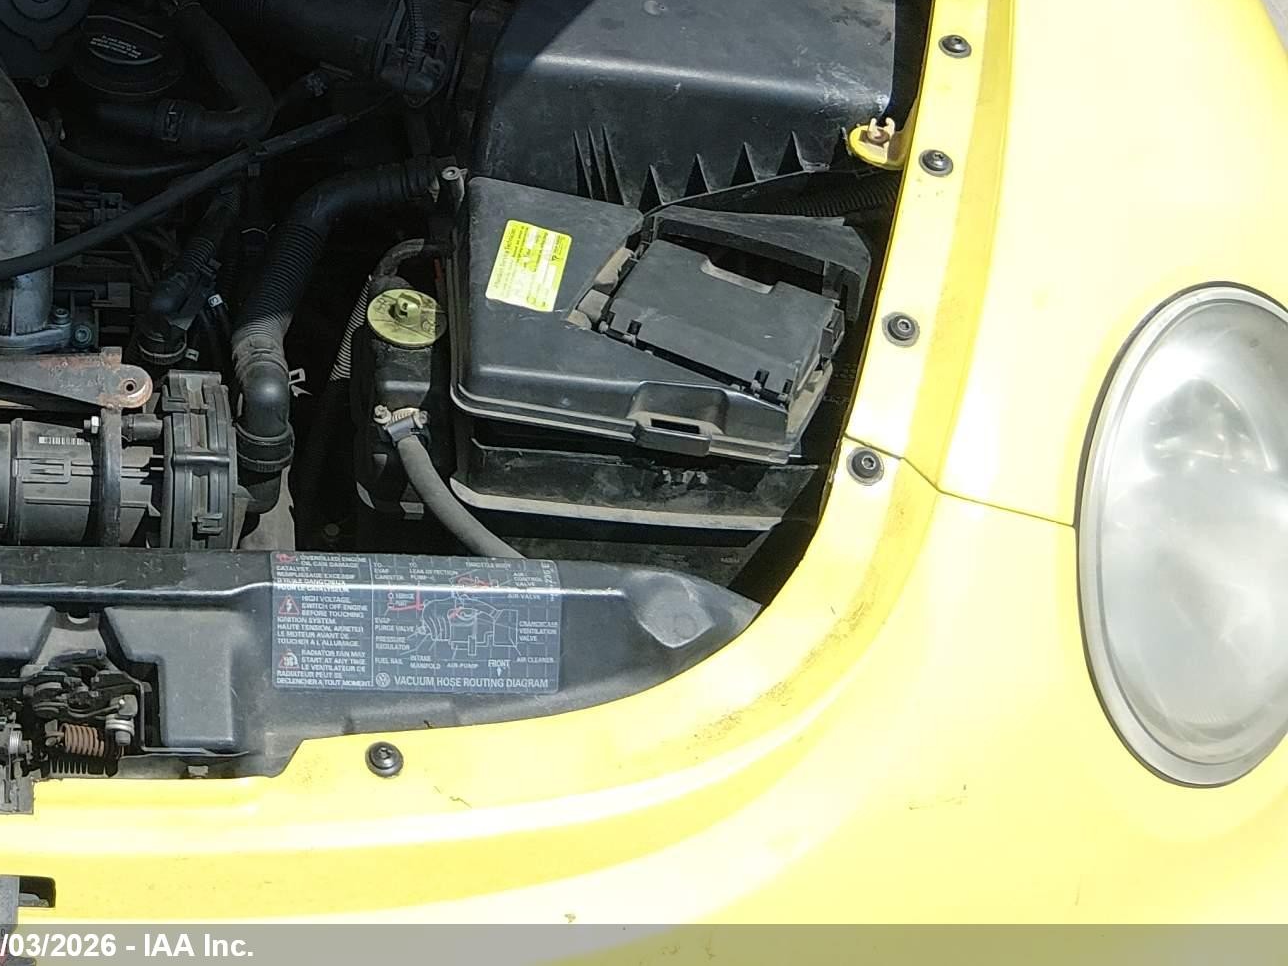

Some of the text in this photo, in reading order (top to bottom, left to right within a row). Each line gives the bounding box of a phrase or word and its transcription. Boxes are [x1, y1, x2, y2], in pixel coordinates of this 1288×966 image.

[487, 659, 510, 667] FRONT
[394, 675, 435, 686] VACUUM
[436, 676, 462, 687] HOSE
[463, 677, 504, 688] ROUTING
[505, 677, 549, 689] DIAGRAM
